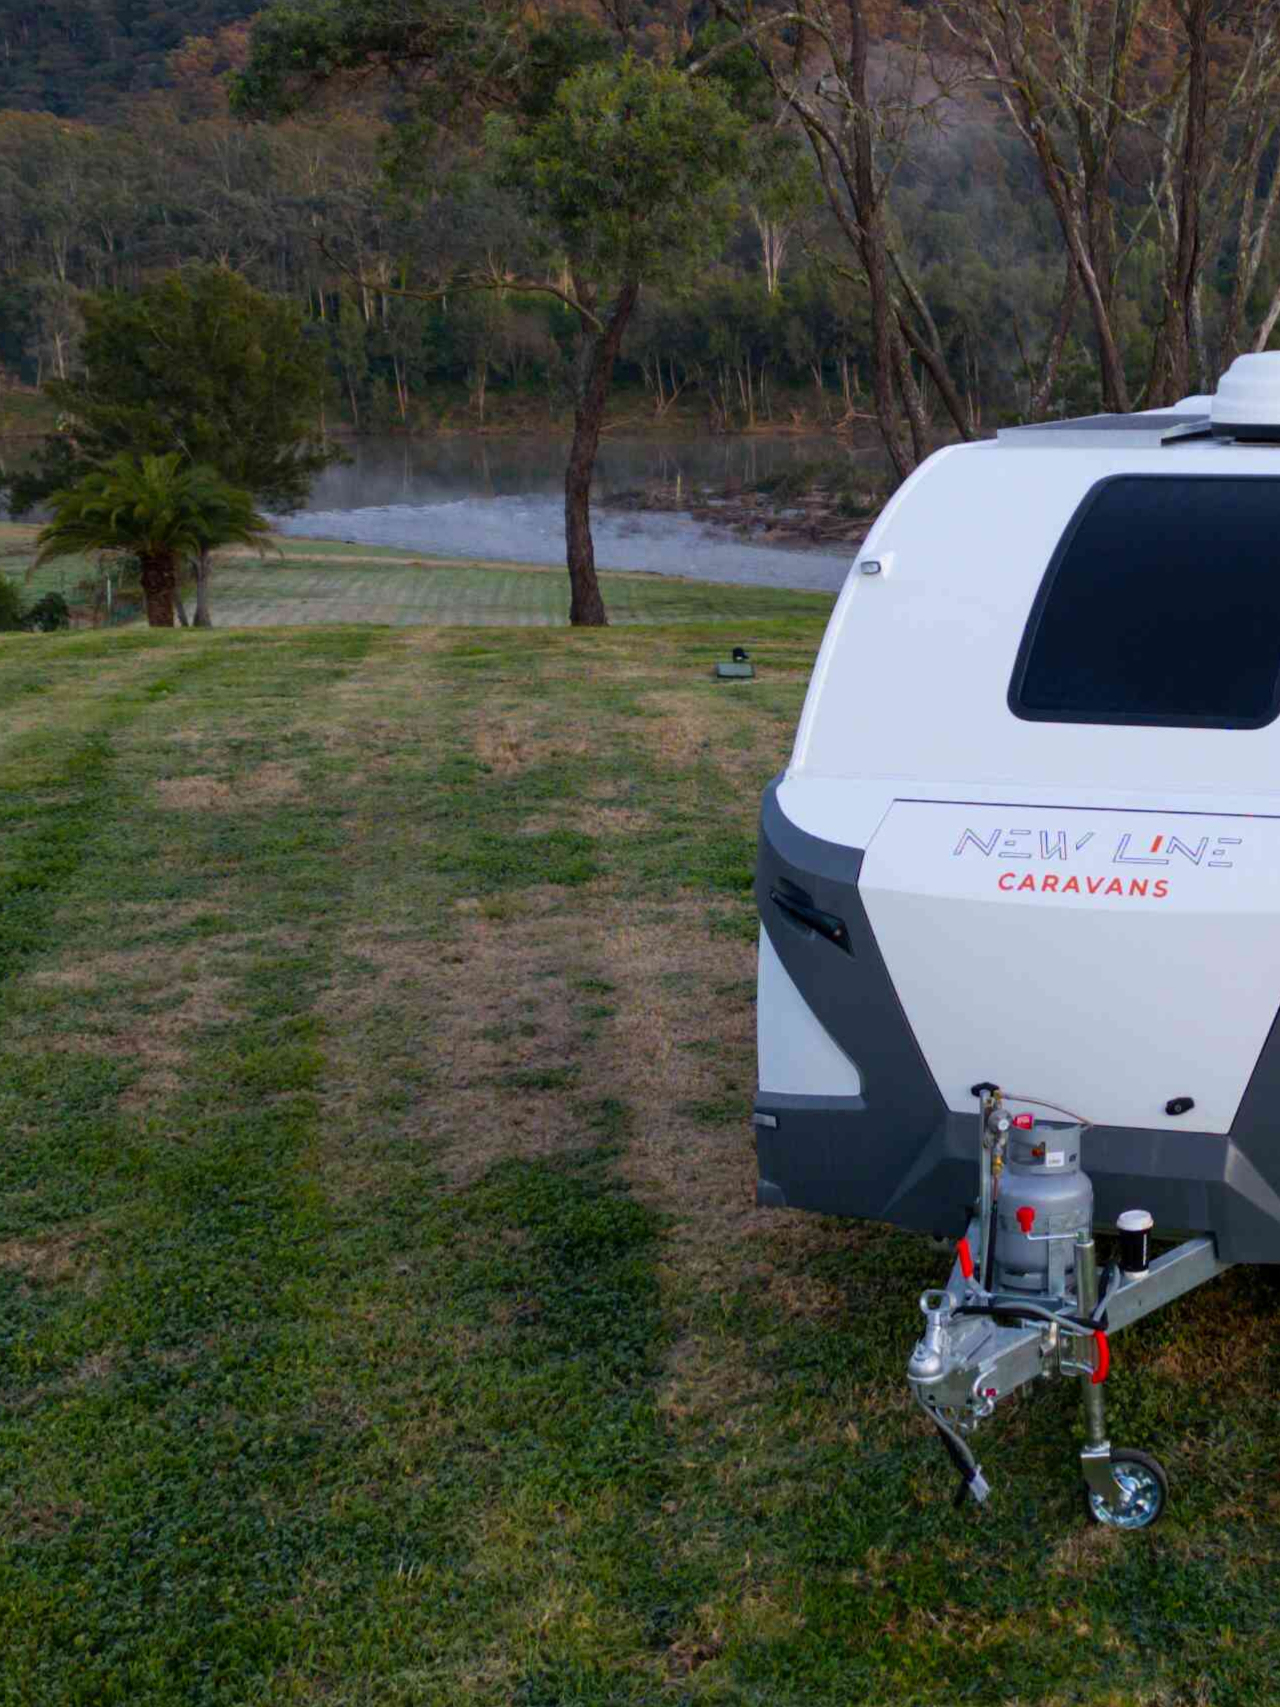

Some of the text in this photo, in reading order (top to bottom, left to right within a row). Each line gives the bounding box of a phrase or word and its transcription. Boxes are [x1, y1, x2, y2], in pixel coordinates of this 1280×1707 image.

[953, 827, 1243, 868] NEW LINE
[997, 871, 1170, 899] CARAVANS
